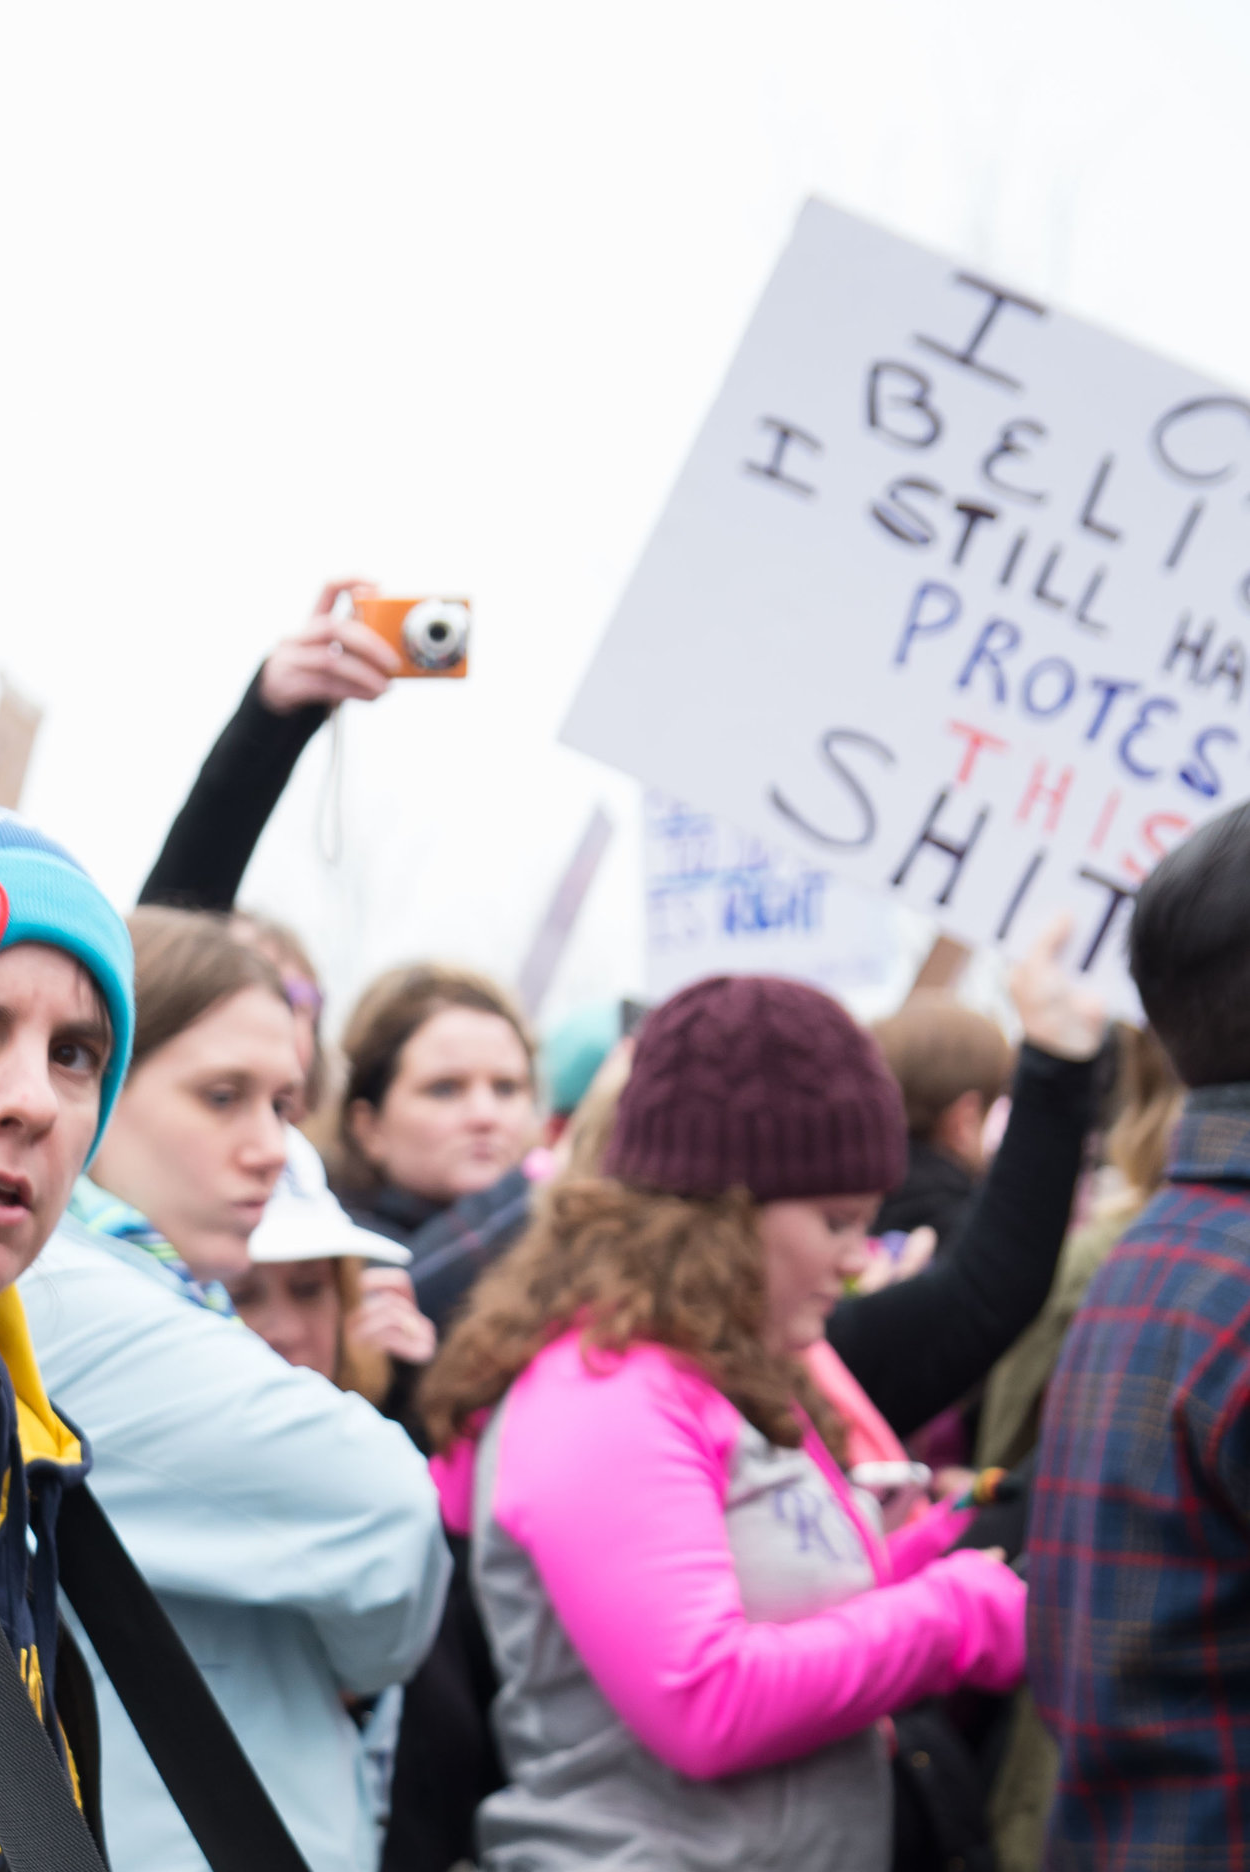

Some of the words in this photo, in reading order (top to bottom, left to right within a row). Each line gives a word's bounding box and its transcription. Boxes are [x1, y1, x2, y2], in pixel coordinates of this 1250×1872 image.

[910, 271, 1047, 393] I
[740, 414, 826, 499] I
[869, 476, 1111, 640] STILL
[1163, 610, 1250, 704] HA
[866, 360, 1250, 600] BELI
[894, 580, 1240, 798] PROTES
[947, 718, 1195, 885] THIS
[766, 727, 1138, 973] SHIT
